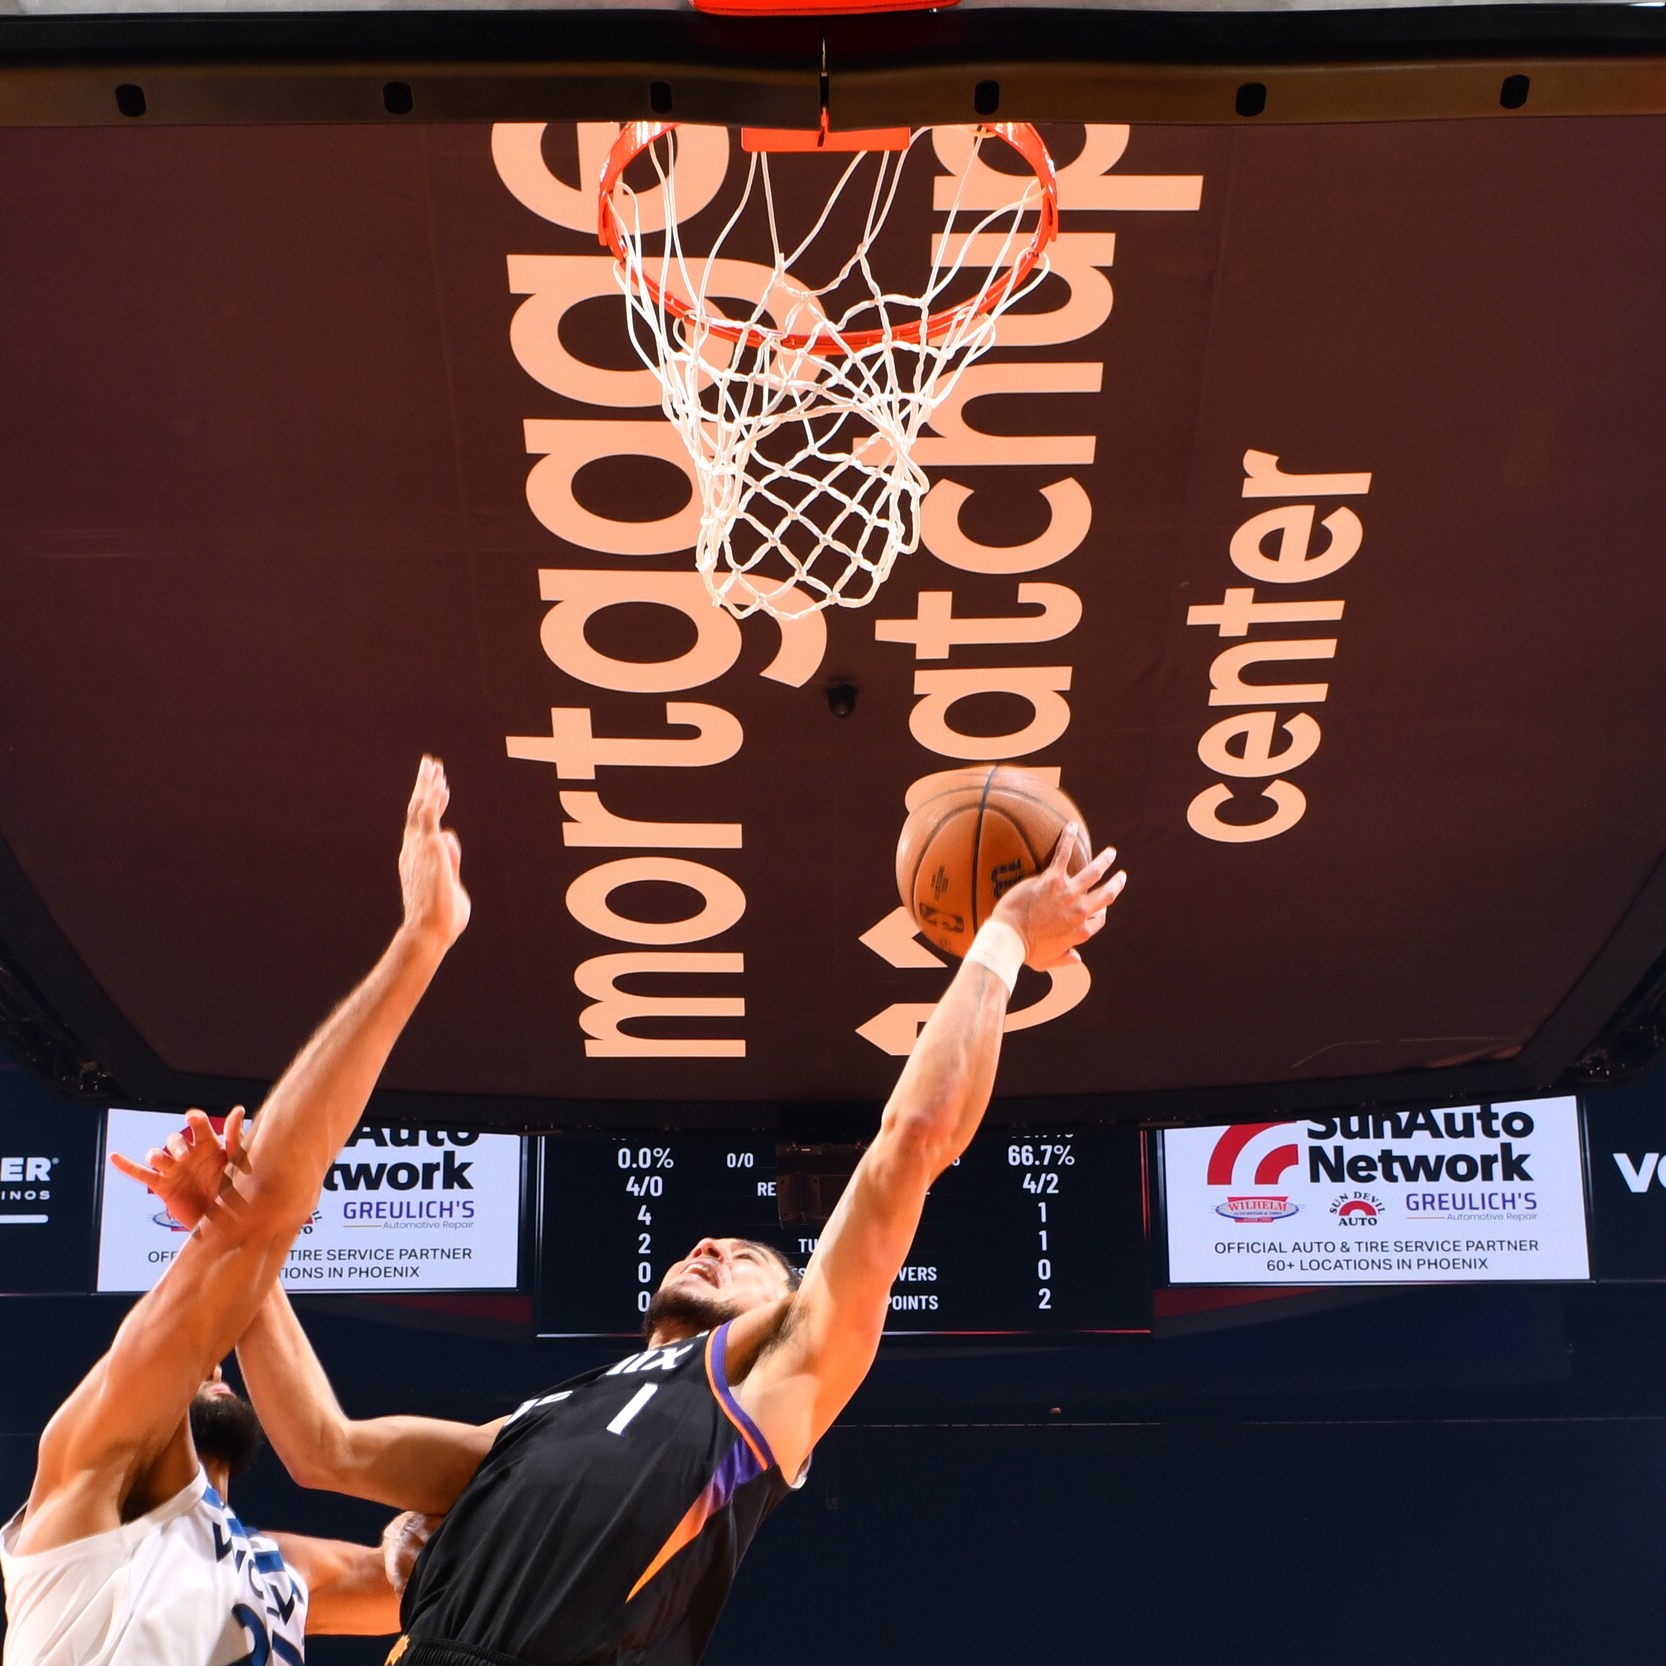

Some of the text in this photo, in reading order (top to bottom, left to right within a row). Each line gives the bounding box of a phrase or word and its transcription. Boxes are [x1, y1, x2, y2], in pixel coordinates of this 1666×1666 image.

[853, 123, 1203, 870] atchup
[490, 123, 827, 1060] mortgage
[1186, 450, 1372, 842] center
[1307, 1104, 1535, 1140] SunAuto
[617, 1146, 674, 1169] 0.0%
[726, 1152, 754, 1168] 0/0
[1007, 1145, 1075, 1167] 66.7%
[1308, 1142, 1533, 1183] Network
[626, 1175, 663, 1197] 4/0
[1023, 1173, 1059, 1194] 4/2
[343, 1201, 475, 1219] GREULICH'S
[1038, 1202, 1047, 1222] 1
[1227, 1200, 1288, 1212] WILHELM
[1329, 1192, 1349, 1215] SUN
[1406, 1192, 1537, 1211] GREULICH'S
[383, 1220, 474, 1231] Automotive Repair
[637, 1205, 653, 1226] 4
[1338, 1217, 1378, 1227] AUTO
[1446, 1211, 1538, 1222] Automotive Repair
[638, 1234, 651, 1254] 2
[1038, 1231, 1047, 1251] 1
[1214, 1239, 1539, 1254] OFFICIAL AUTO & TIRE SERVICE PARTNER
[327, 1248, 472, 1261] SERVICE PARTNER
[1266, 1258, 1488, 1272] 60+ LOCATIONS IN PHOENIX
[328, 1266, 420, 1278] IN PHOENIX
[638, 1263, 651, 1284] 0
[1038, 1259, 1051, 1280] 0
[1038, 1288, 1052, 1310] 2
[605, 1382, 659, 1437] 1
